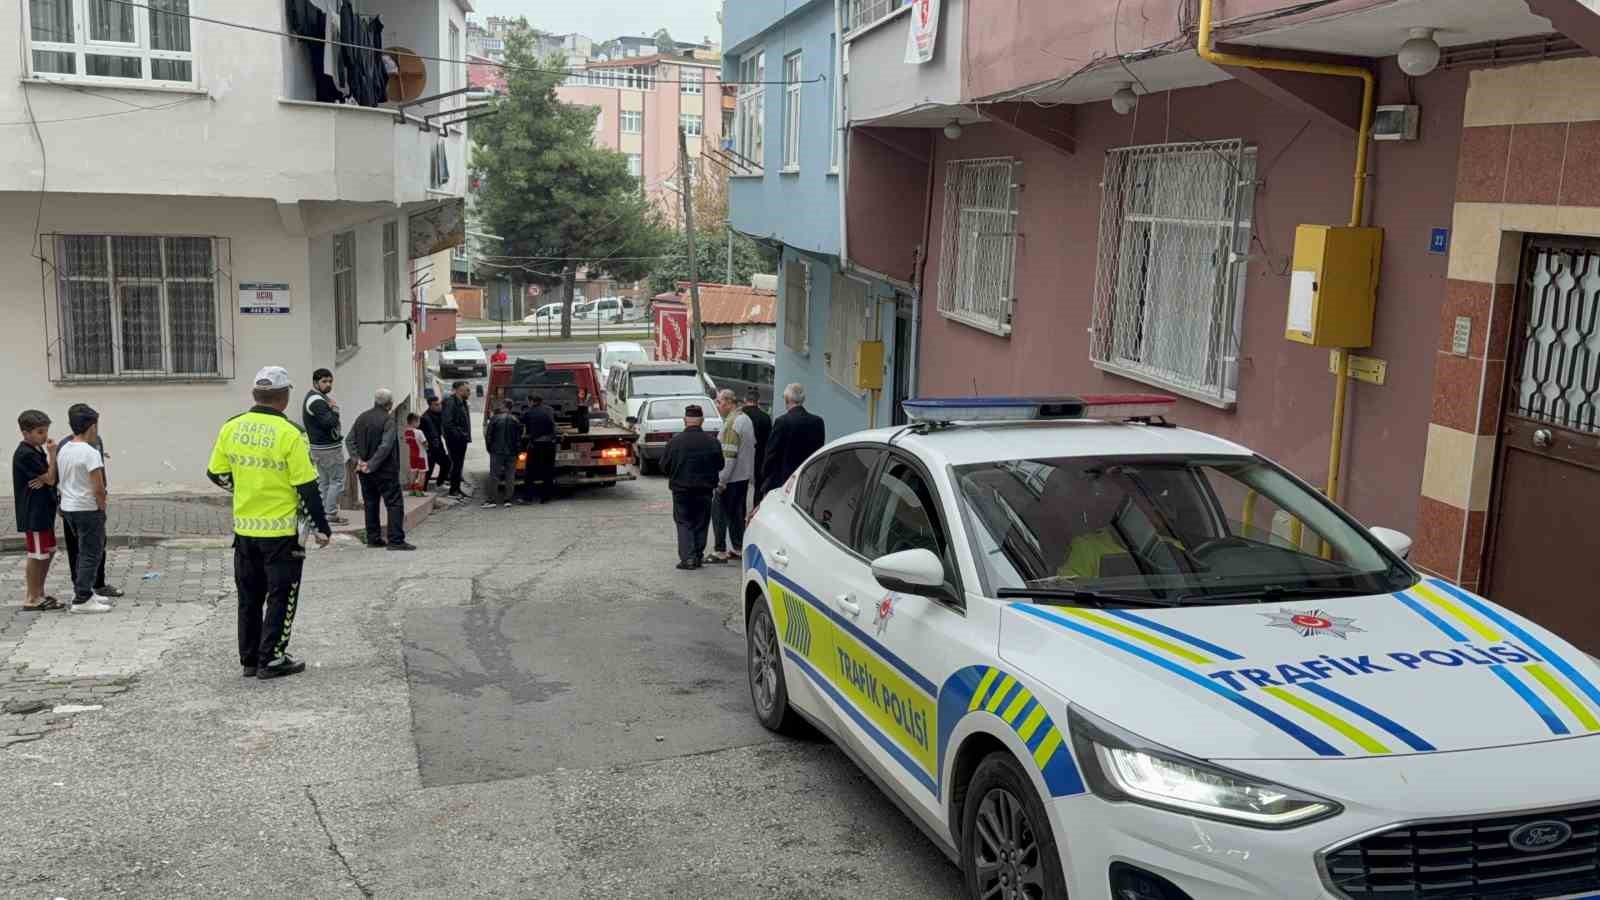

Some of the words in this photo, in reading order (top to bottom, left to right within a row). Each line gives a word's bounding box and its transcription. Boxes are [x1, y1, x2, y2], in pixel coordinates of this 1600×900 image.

[836, 645, 882, 709] TRAFİK
[881, 683, 929, 753] POLİSİ
[1208, 653, 1394, 691] TRAFİK
[1386, 640, 1545, 670] POLİSİ
